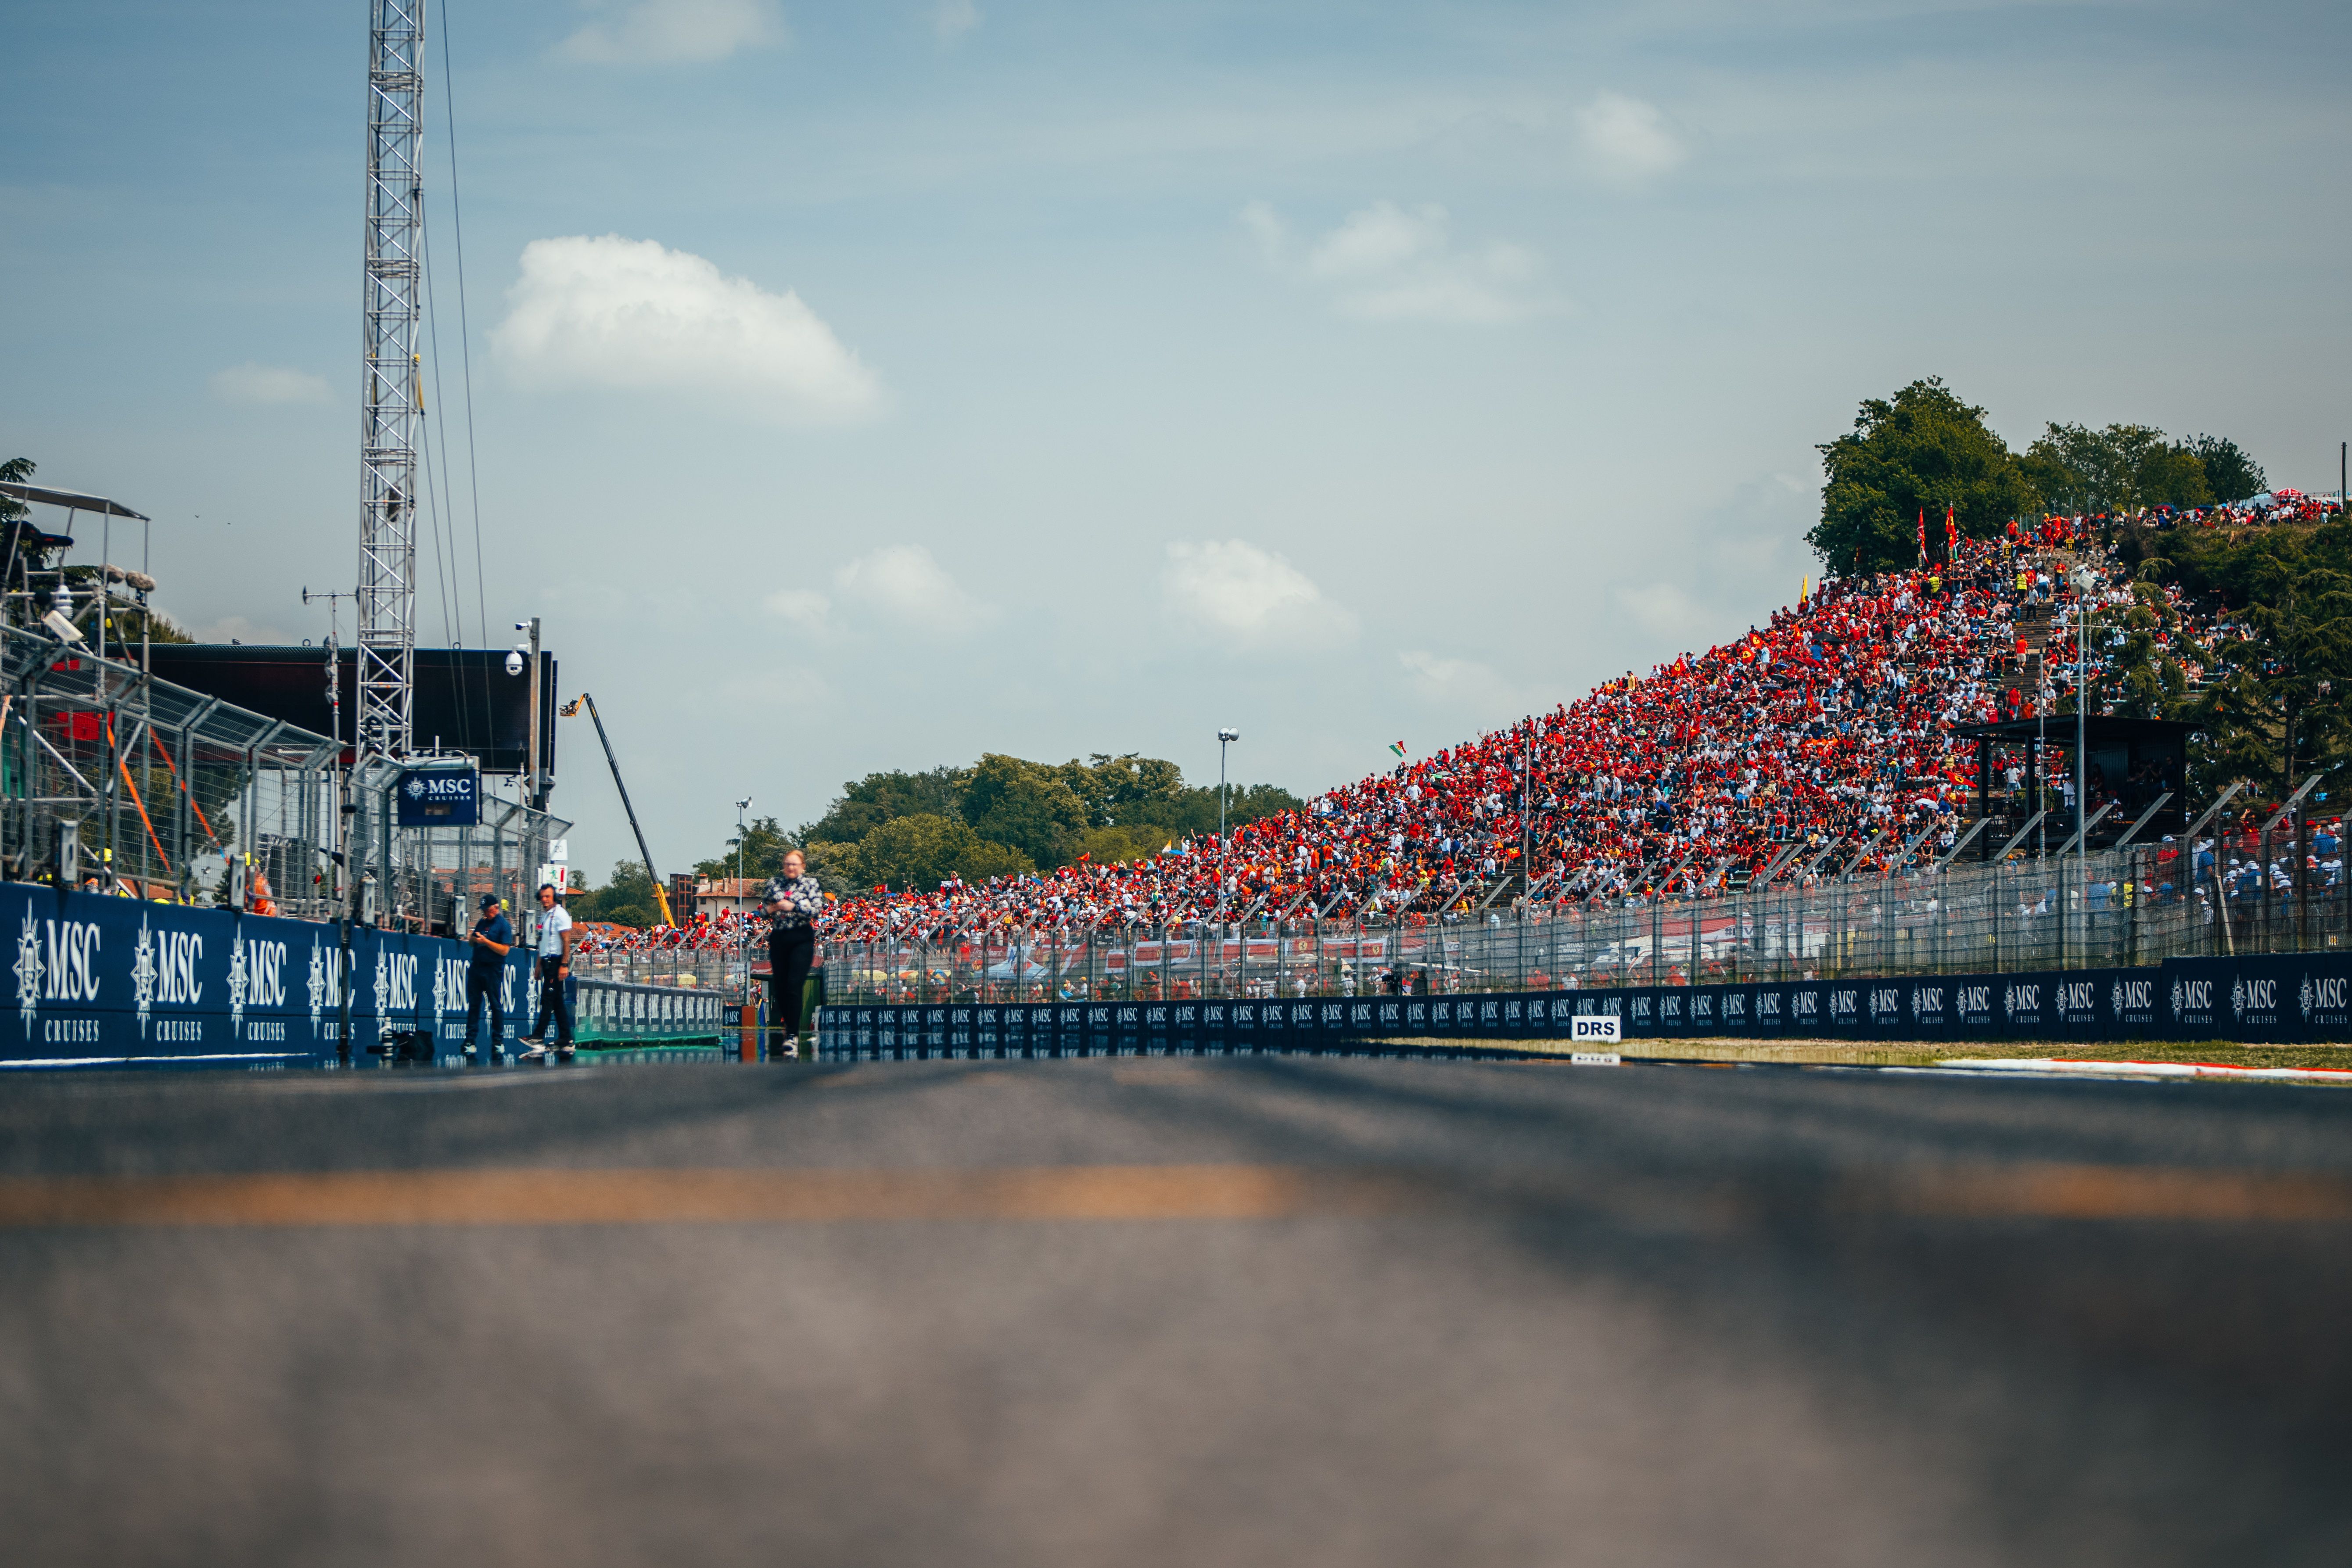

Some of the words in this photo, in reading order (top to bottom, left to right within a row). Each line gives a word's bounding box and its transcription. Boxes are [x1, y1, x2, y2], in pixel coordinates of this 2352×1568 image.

[428, 779, 470, 793] MSC
[45, 919, 100, 1001] MSC
[157, 930, 202, 1004] MSC
[249, 939, 287, 1007] MSC
[389, 953, 417, 1010] MSC
[446, 959, 470, 1011] MSC
[500, 965, 516, 1013] SC
[2315, 978, 2346, 1008] MSC
[1800, 992, 1817, 1013] MSC
[1838, 990, 1856, 1012] MSC
[1878, 989, 1898, 1012] MSC
[1922, 988, 1943, 1011] MSC
[1968, 987, 1989, 1011] MSC
[2016, 985, 2039, 1010] MSC
[2068, 982, 2093, 1008] MSC
[2125, 981, 2151, 1008] MSC
[2184, 981, 2212, 1008] MSC
[2247, 980, 2276, 1008] MSC
[1385, 1004, 1398, 1019] MSC
[1412, 1004, 1424, 1019] MSC
[1438, 1003, 1449, 1019] MSC
[1461, 1002, 1473, 1018] MSC
[1486, 1001, 1497, 1018] MSC
[1510, 1001, 1520, 1018] MSC
[1533, 1000, 1544, 1017] MSC
[1557, 999, 1569, 1017] MSC
[1582, 998, 1594, 1015] MSC
[1609, 997, 1621, 1015] MSC
[1637, 997, 1650, 1015] MSC
[1666, 996, 1680, 1015] MSC
[1697, 995, 1712, 1015] MSC
[1728, 994, 1745, 1014] MSC
[1763, 993, 1780, 1013] MSC
[883, 1011, 894, 1023] MSC
[907, 1010, 919, 1022] MSC
[932, 1010, 944, 1022] MSC
[957, 1010, 970, 1022] MSC
[984, 1009, 996, 1022] MSC
[1010, 1009, 1023, 1022] MSC
[1038, 1009, 1051, 1022] MSC
[1066, 1008, 1079, 1022] MSC
[1095, 1008, 1108, 1021] MSC
[1123, 1008, 1137, 1021] MSC
[1153, 1007, 1166, 1021] MSC
[1181, 1007, 1194, 1020] MSC
[1210, 1006, 1223, 1020] MSC
[1239, 1006, 1253, 1020] MSC
[1269, 1005, 1282, 1020] MSC
[1298, 1005, 1312, 1019] MSC
[1328, 1005, 1342, 1019] MSC
[1357, 1005, 1370, 1019] MSC
[2315, 1015, 2347, 1023] CRUISES
[45, 1019, 99, 1042] CRUISES
[156, 1021, 201, 1041] CRUISES
[248, 1022, 285, 1041] CRUISES
[1577, 1022, 1615, 1036] DRS
